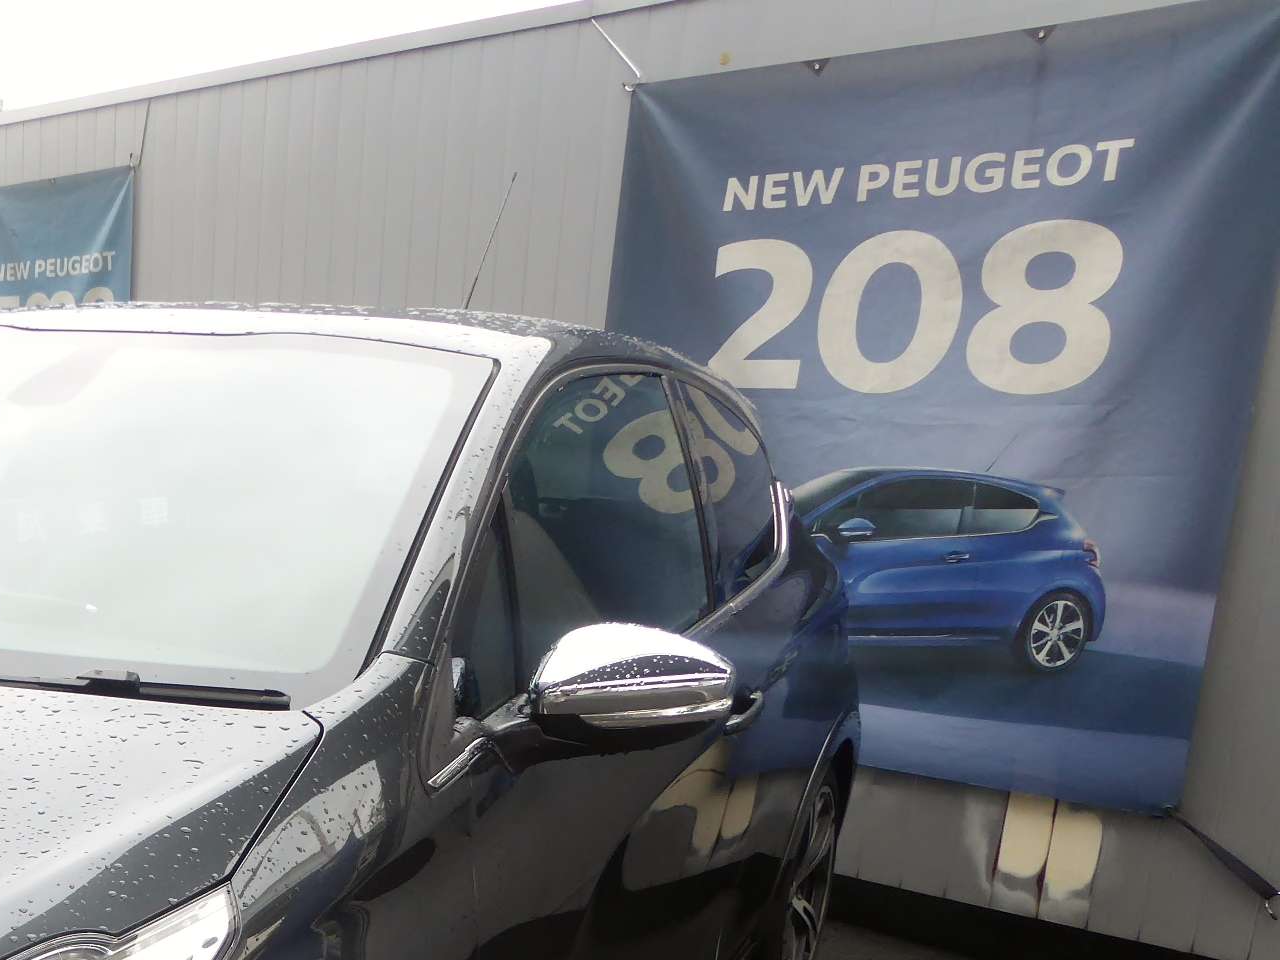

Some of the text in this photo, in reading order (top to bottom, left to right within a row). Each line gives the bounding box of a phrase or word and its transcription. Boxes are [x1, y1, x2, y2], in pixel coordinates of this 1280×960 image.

[722, 138, 1135, 211] NEW PEUGEOT
[35, 251, 116, 280] PEUGEOT
[708, 219, 1123, 394] 208
